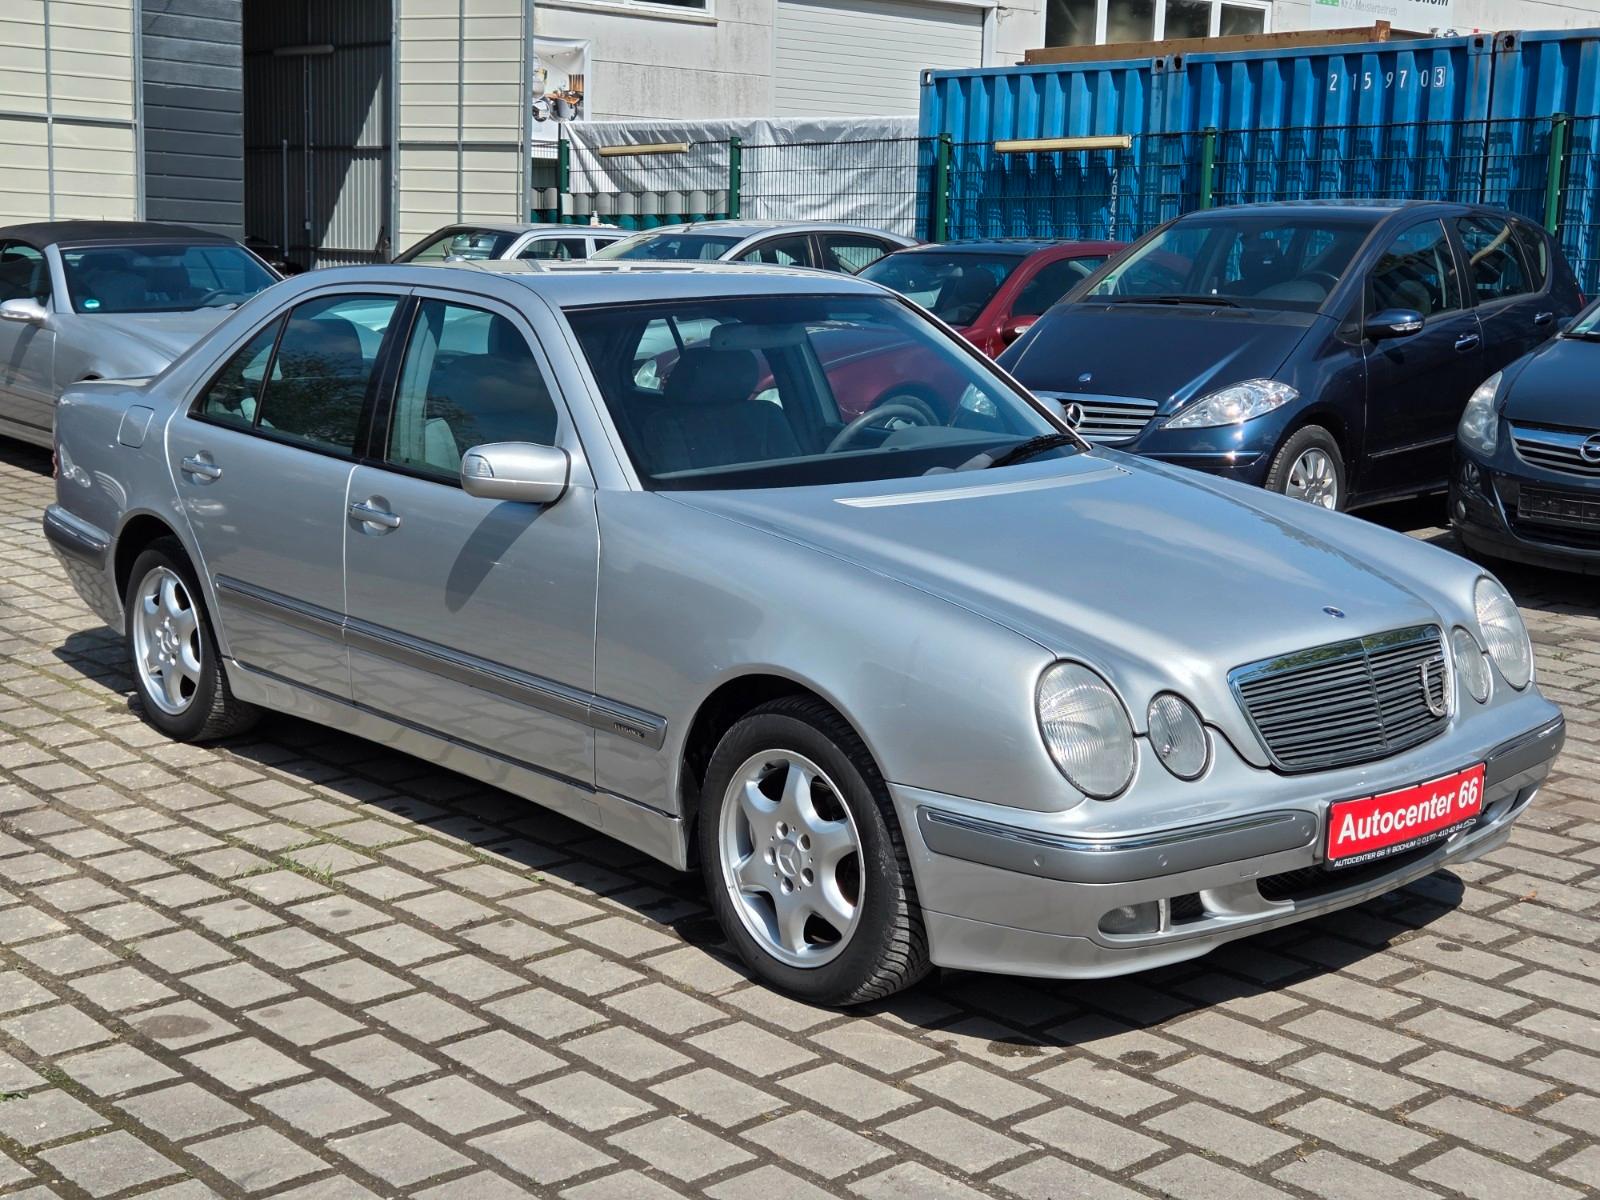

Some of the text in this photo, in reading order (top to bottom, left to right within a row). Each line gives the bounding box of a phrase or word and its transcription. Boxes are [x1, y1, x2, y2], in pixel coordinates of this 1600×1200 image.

[1337, 776, 1479, 844] Autocenter 66
[1334, 853, 1376, 867] AUTOCENTER
